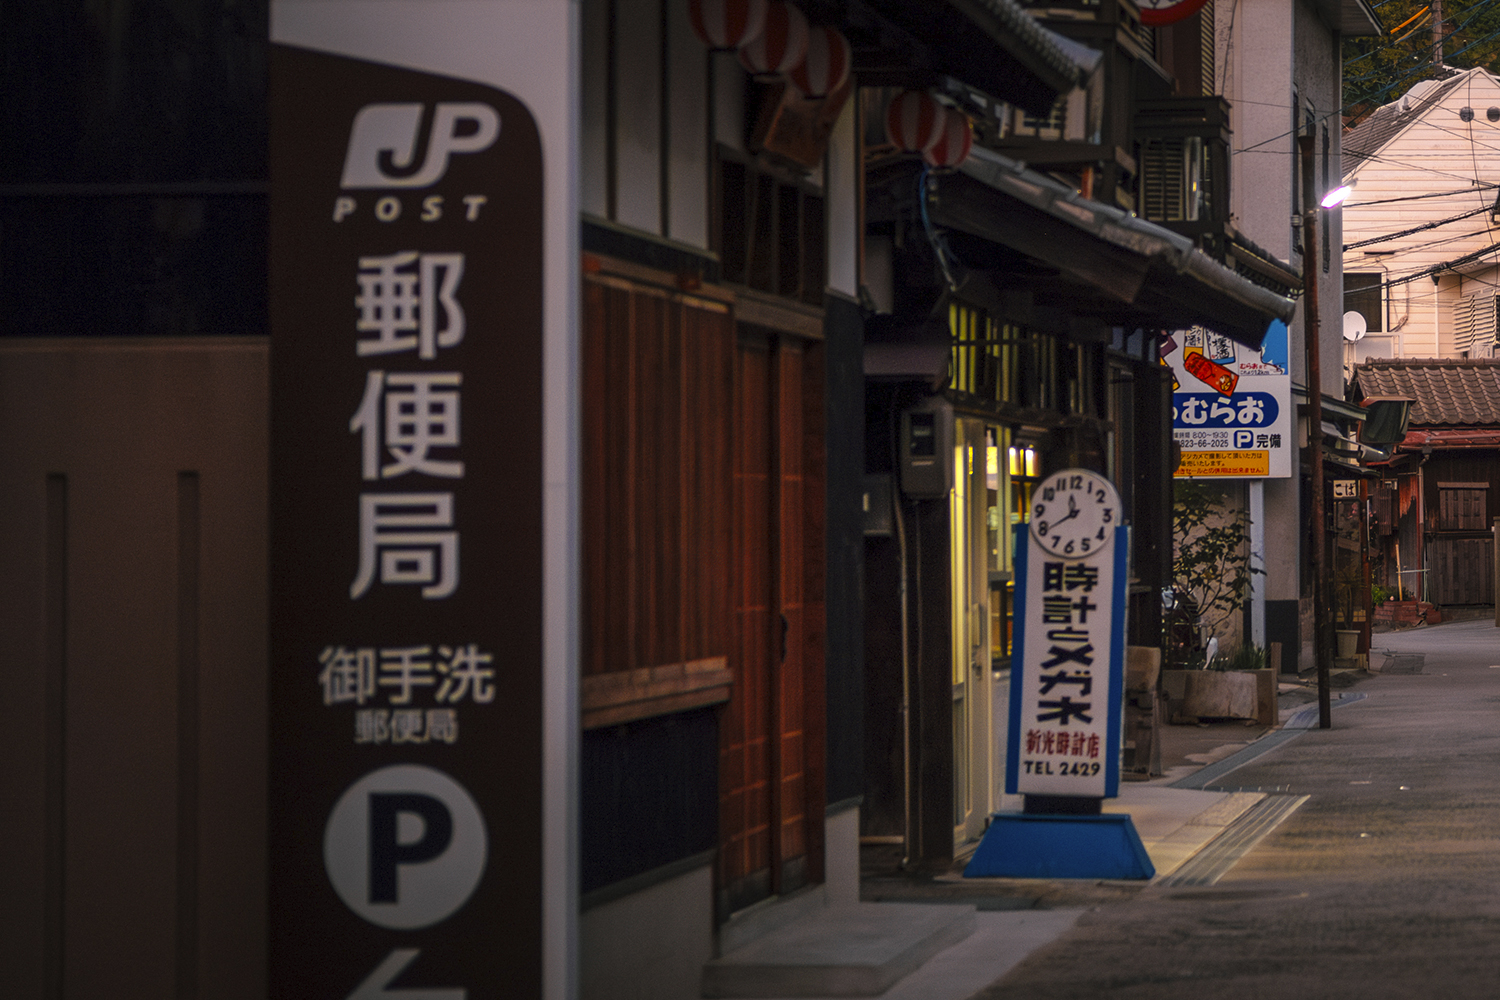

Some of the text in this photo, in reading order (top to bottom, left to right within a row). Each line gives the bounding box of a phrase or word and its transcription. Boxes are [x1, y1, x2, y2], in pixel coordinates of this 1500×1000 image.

[340, 102, 500, 190] JP
[333, 195, 487, 222] POST
[348, 251, 466, 600] 郵便局
[1237, 432, 1281, 448] P 完備
[1056, 478, 1067, 491] 11
[1070, 475, 1083, 490] 12
[1087, 481, 1092, 494] 1
[1043, 487, 1055, 501] 10
[1096, 489, 1106, 503] 2
[1034, 504, 1045, 518] 9
[1103, 508, 1112, 523] 3
[1038, 521, 1048, 537] 8
[1096, 526, 1105, 541] 4
[1052, 535, 1061, 548] 7
[1064, 540, 1074, 554] 6
[1081, 538, 1091, 552] 5
[1036, 561, 1098, 726] 時計とメガネ
[318, 645, 496, 705] 御手洗
[354, 708, 460, 745] 郵便局
[1026, 729, 1100, 758] 新光時計店
[1024, 761, 1101, 776] TEL 2429
[367, 791, 454, 904] P
